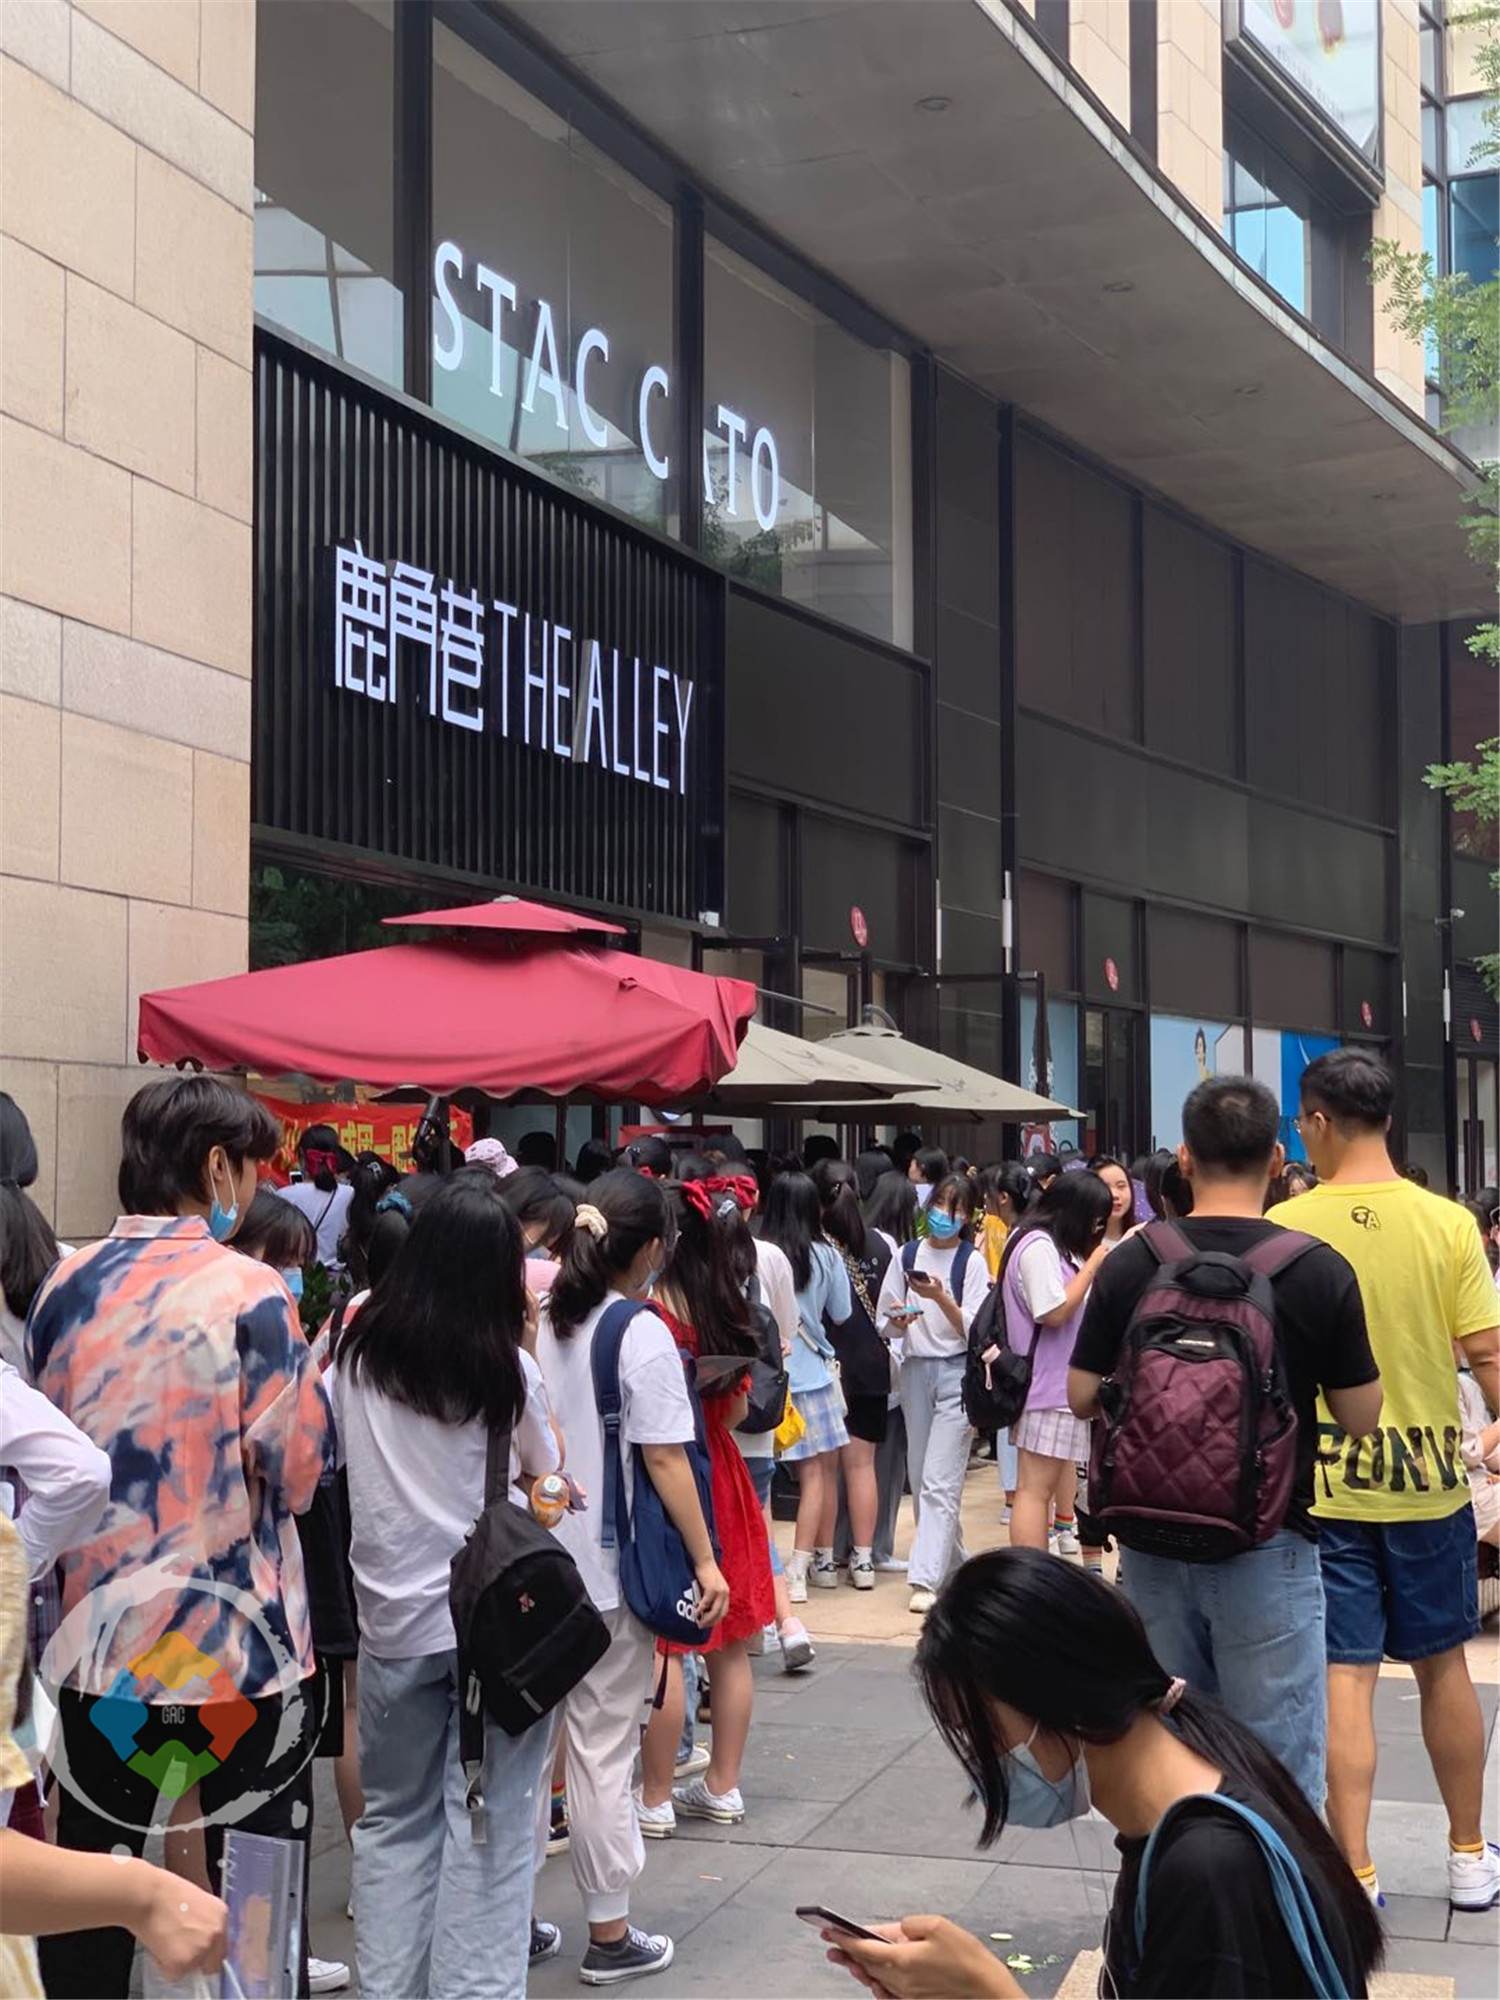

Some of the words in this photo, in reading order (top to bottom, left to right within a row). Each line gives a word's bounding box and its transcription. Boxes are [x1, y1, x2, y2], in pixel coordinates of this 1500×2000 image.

[433, 241, 780, 532] STACCTO
[335, 539, 484, 732] 鹿角巷
